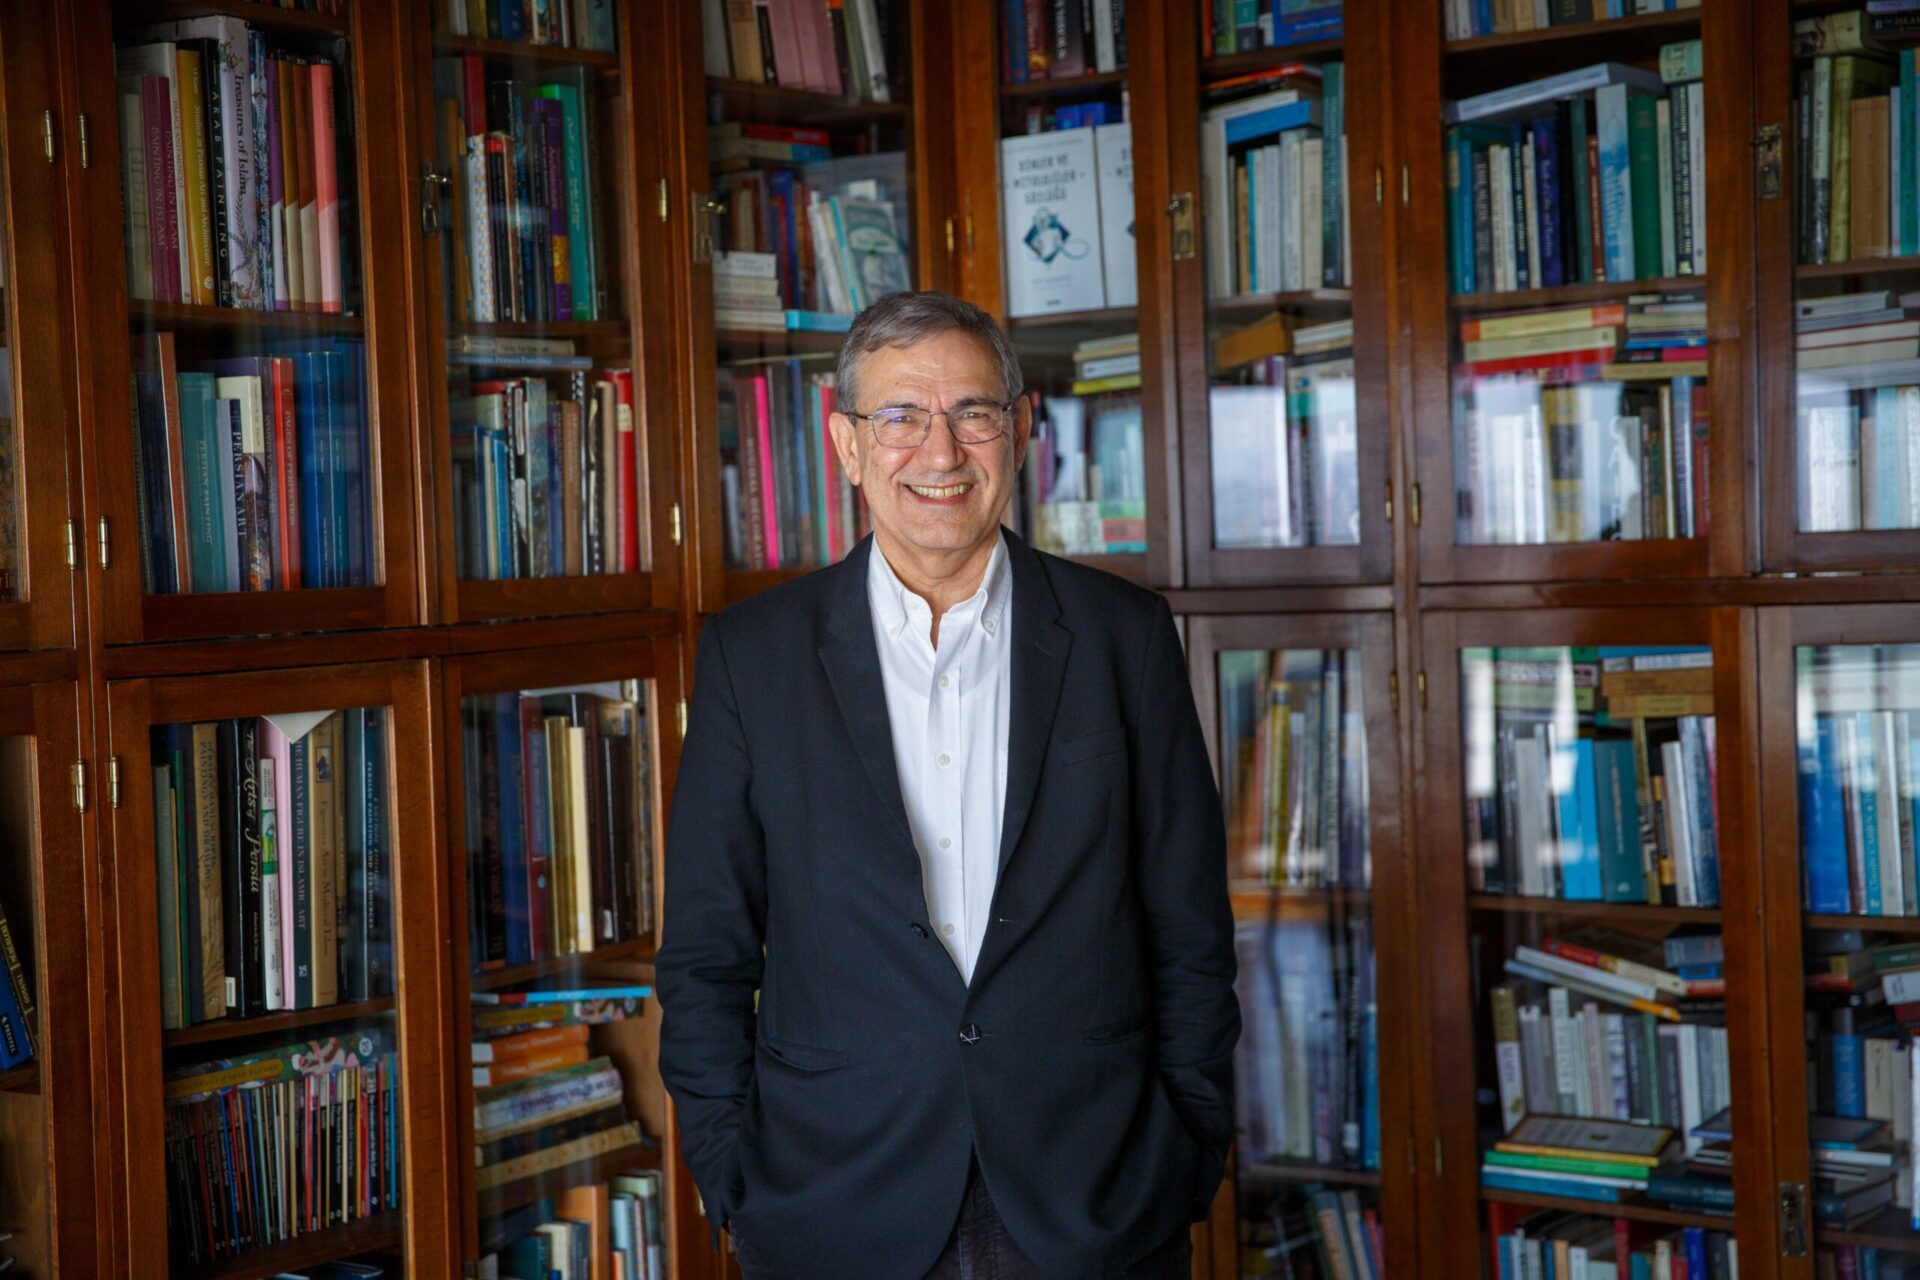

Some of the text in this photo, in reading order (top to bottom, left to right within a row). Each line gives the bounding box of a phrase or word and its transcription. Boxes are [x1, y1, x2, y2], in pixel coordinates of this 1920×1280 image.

[193, 105, 203, 137] Studies
[234, 71, 250, 195] Treasures of Islam
[151, 127, 166, 247] PAINTING IN ISLAM
[165, 129, 179, 249] PAINTING IN ISLAM
[196, 149, 206, 179] Persian
[199, 181, 208, 195] Art
[212, 91, 228, 260] ARAB PAINTING
[200, 197, 209, 212] and
[201, 214, 212, 266] Architecture
[199, 440, 214, 545] PERSIAN PAINTING
[232, 431, 248, 540] PERSIAN ART
[284, 409, 296, 527] PAGES OF PERFECTION
[246, 728, 255, 749] The
[243, 757, 259, 807] Arts
[295, 759, 305, 799] HUMAN
[200, 741, 211, 890] PAINTINGS AND DRAWINGS
[296, 802, 306, 842] FIGURE
[244, 827, 261, 894] Persia
[297, 845, 306, 856] IN
[297, 858, 307, 903] ISLAMIC
[298, 906, 307, 931] ART
